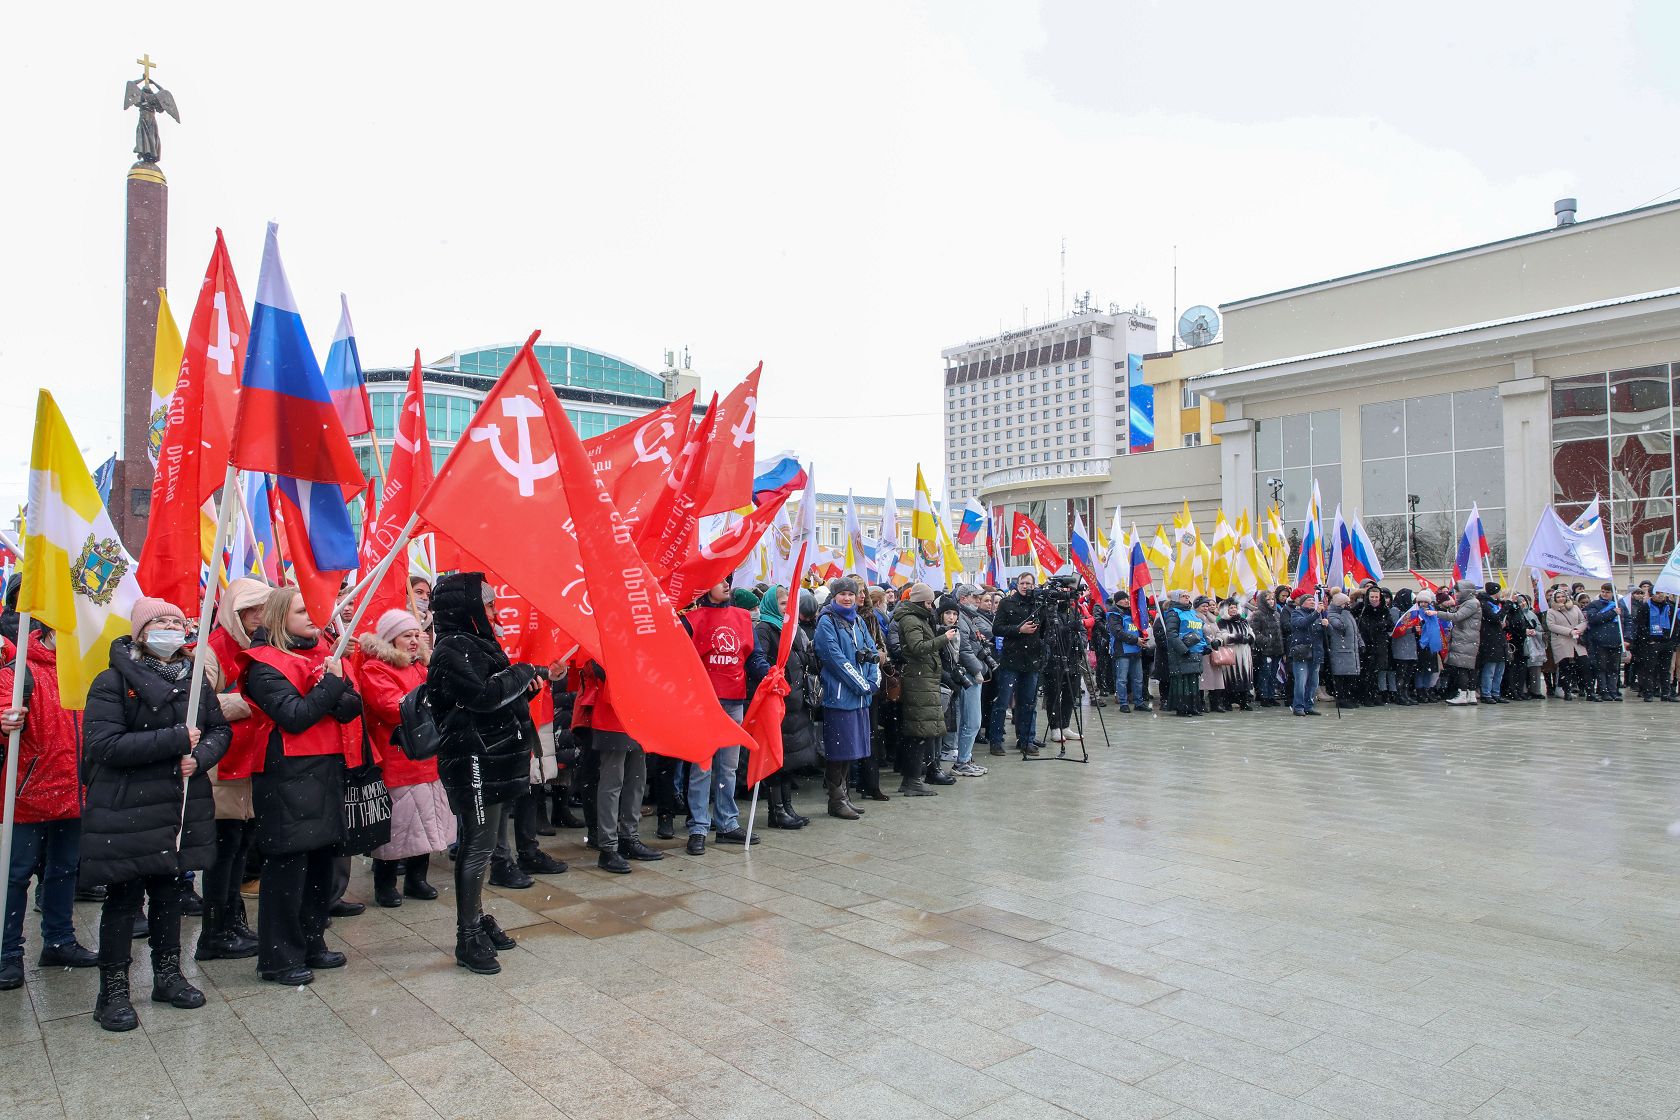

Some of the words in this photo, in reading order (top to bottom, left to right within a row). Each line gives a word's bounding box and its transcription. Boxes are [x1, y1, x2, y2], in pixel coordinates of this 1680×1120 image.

[709, 655, 739, 665] КПРФ
[361, 780, 388, 802] MOMENTS
[344, 803, 357, 829] OT
[359, 795, 391, 828] THINGS
